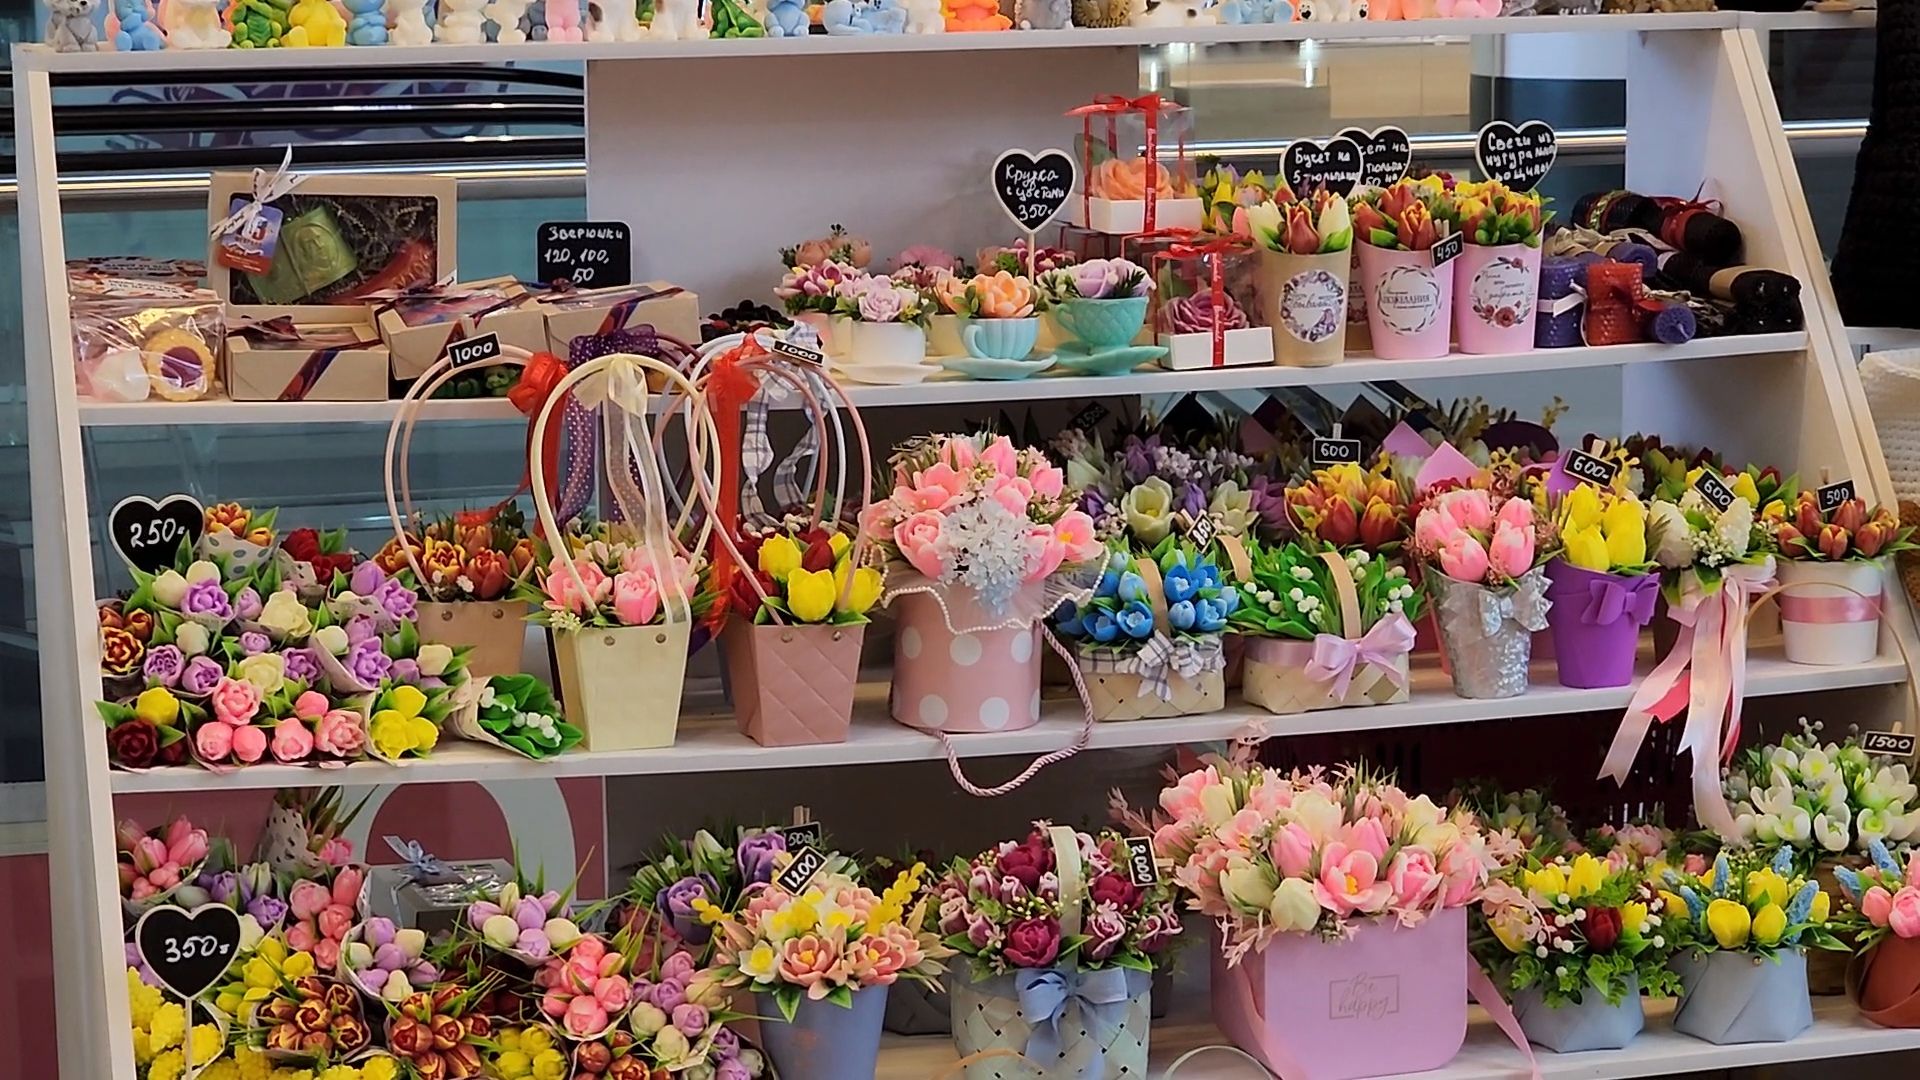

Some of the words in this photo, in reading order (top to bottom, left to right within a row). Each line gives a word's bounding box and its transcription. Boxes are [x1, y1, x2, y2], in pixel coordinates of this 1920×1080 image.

[1006, 163, 1060, 190] Кружка
[1292, 170, 1301, 184] 5
[548, 227, 623, 241] Зверюшки
[1437, 241, 1458, 260] 450
[572, 267, 595, 284] 50
[455, 342, 493, 364] 1000
[781, 344, 818, 360] 1000
[1320, 442, 1349, 458] 600
[1704, 479, 1731, 506] 600
[1826, 487, 1849, 505] 500
[1868, 734, 1911, 750] 1500
[783, 853, 817, 888] 1200
[1131, 844, 1153, 883] 2000
